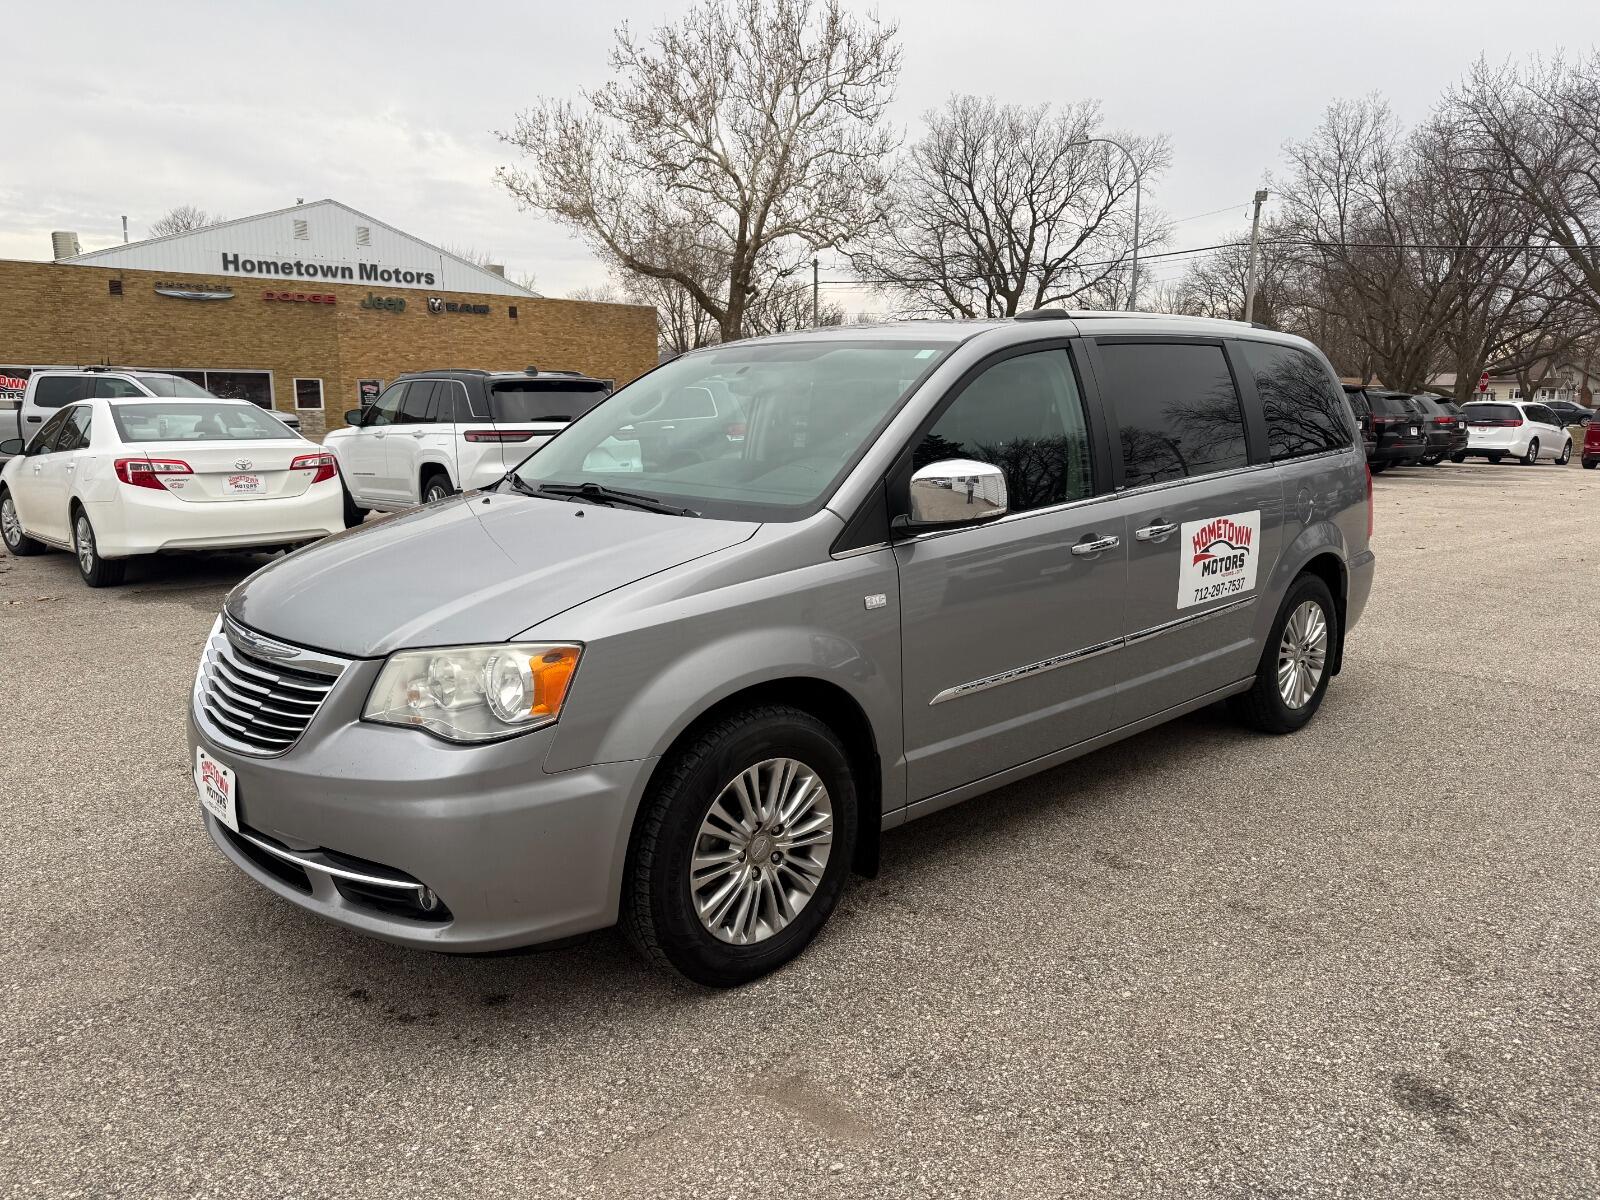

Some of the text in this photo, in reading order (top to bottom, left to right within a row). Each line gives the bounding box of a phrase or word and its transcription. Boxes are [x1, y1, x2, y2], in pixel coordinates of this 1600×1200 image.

[222, 252, 435, 285] Hometown Motors
[263, 291, 337, 304] DODGE
[362, 292, 406, 314] Jeep
[446, 302, 489, 314] RAM
[1192, 519, 1252, 554] HOMETOWN
[1202, 553, 1245, 577] MOTORS
[1194, 577, 1246, 602] 712-297-7537
